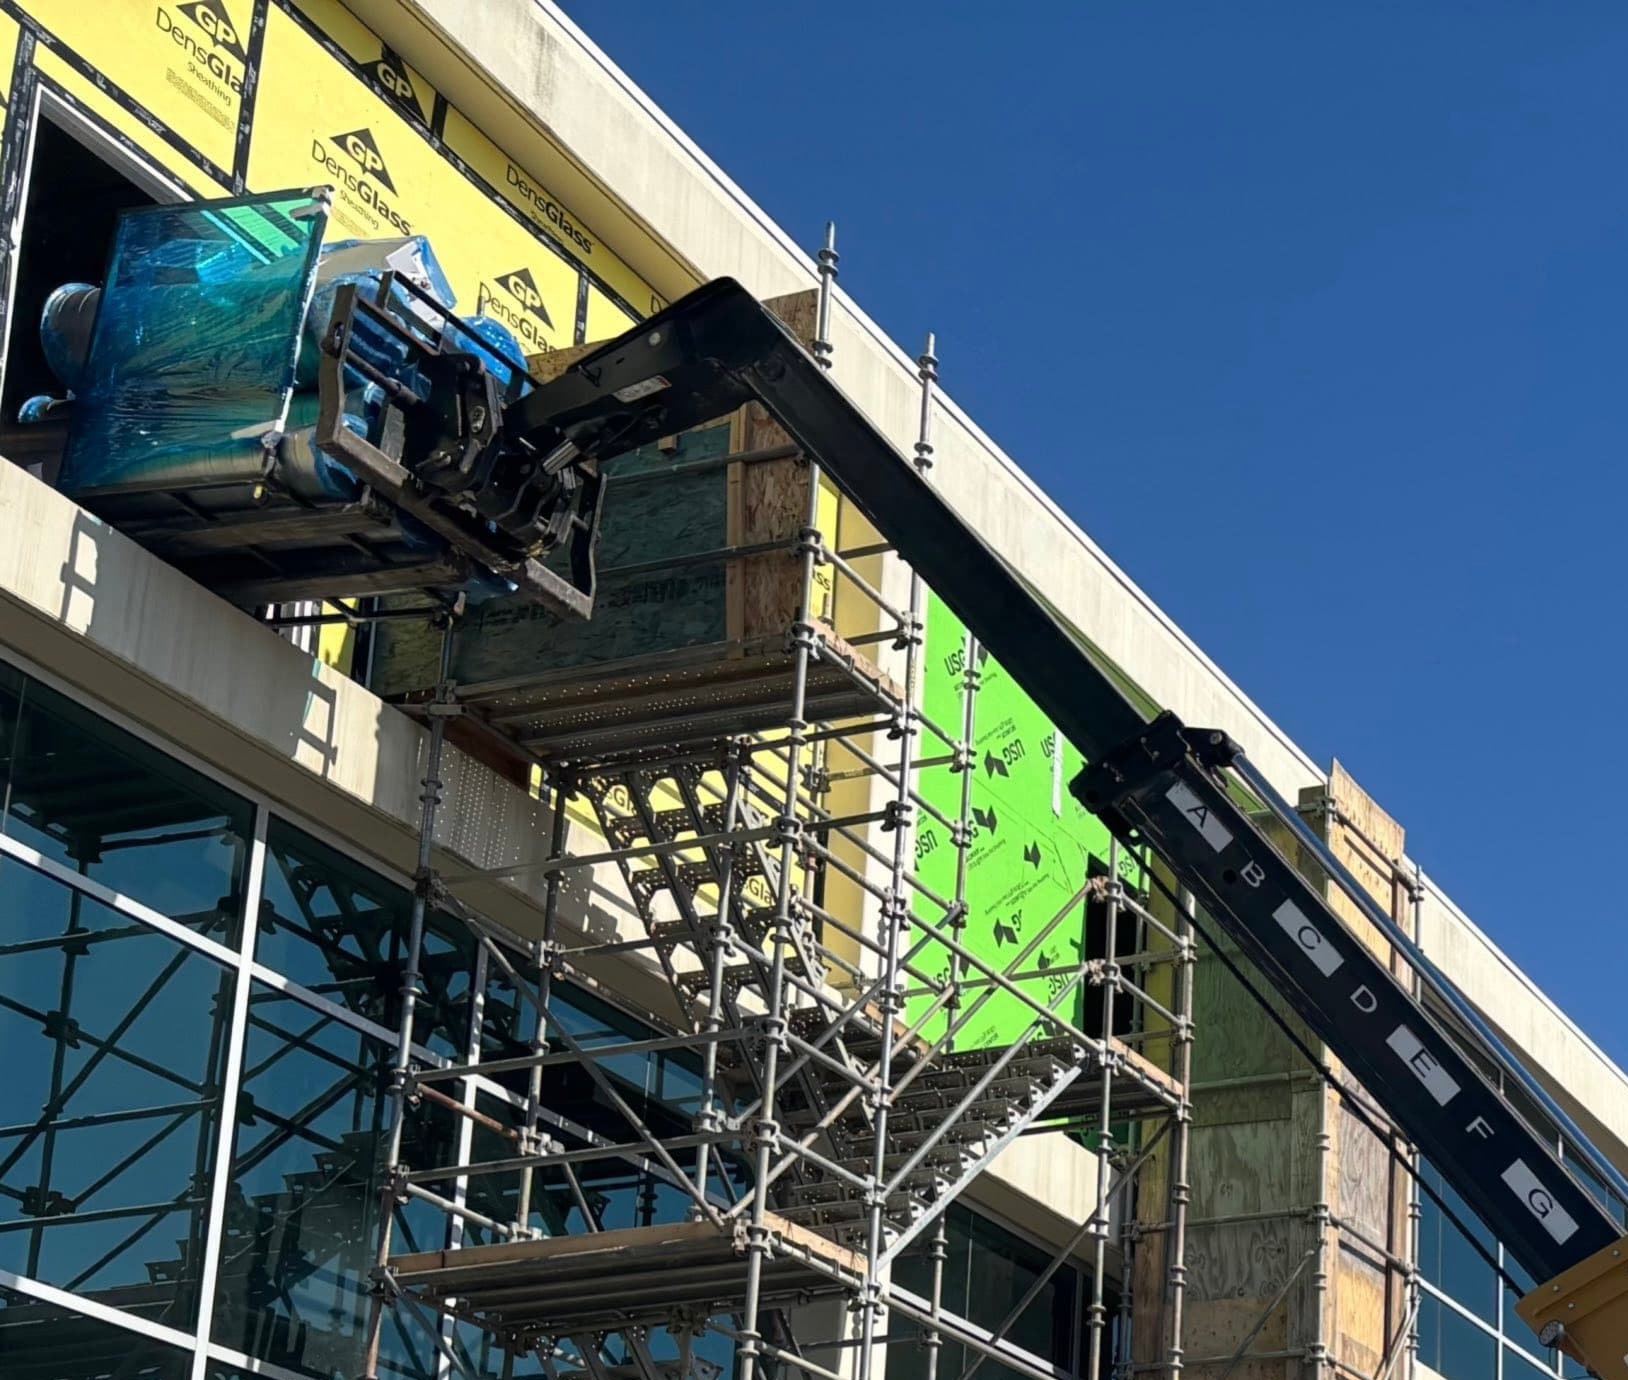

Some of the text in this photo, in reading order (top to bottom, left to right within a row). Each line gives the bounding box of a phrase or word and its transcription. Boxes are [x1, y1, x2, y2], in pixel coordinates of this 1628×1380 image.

[195, 4, 240, 45] GP
[376, 62, 413, 98] GP
[346, 134, 385, 171] GP
[311, 138, 411, 237] DensGlass
[506, 163, 593, 255] DensGlass
[508, 274, 542, 308] GP
[1186, 805, 1554, 1220] A B C D E F G
